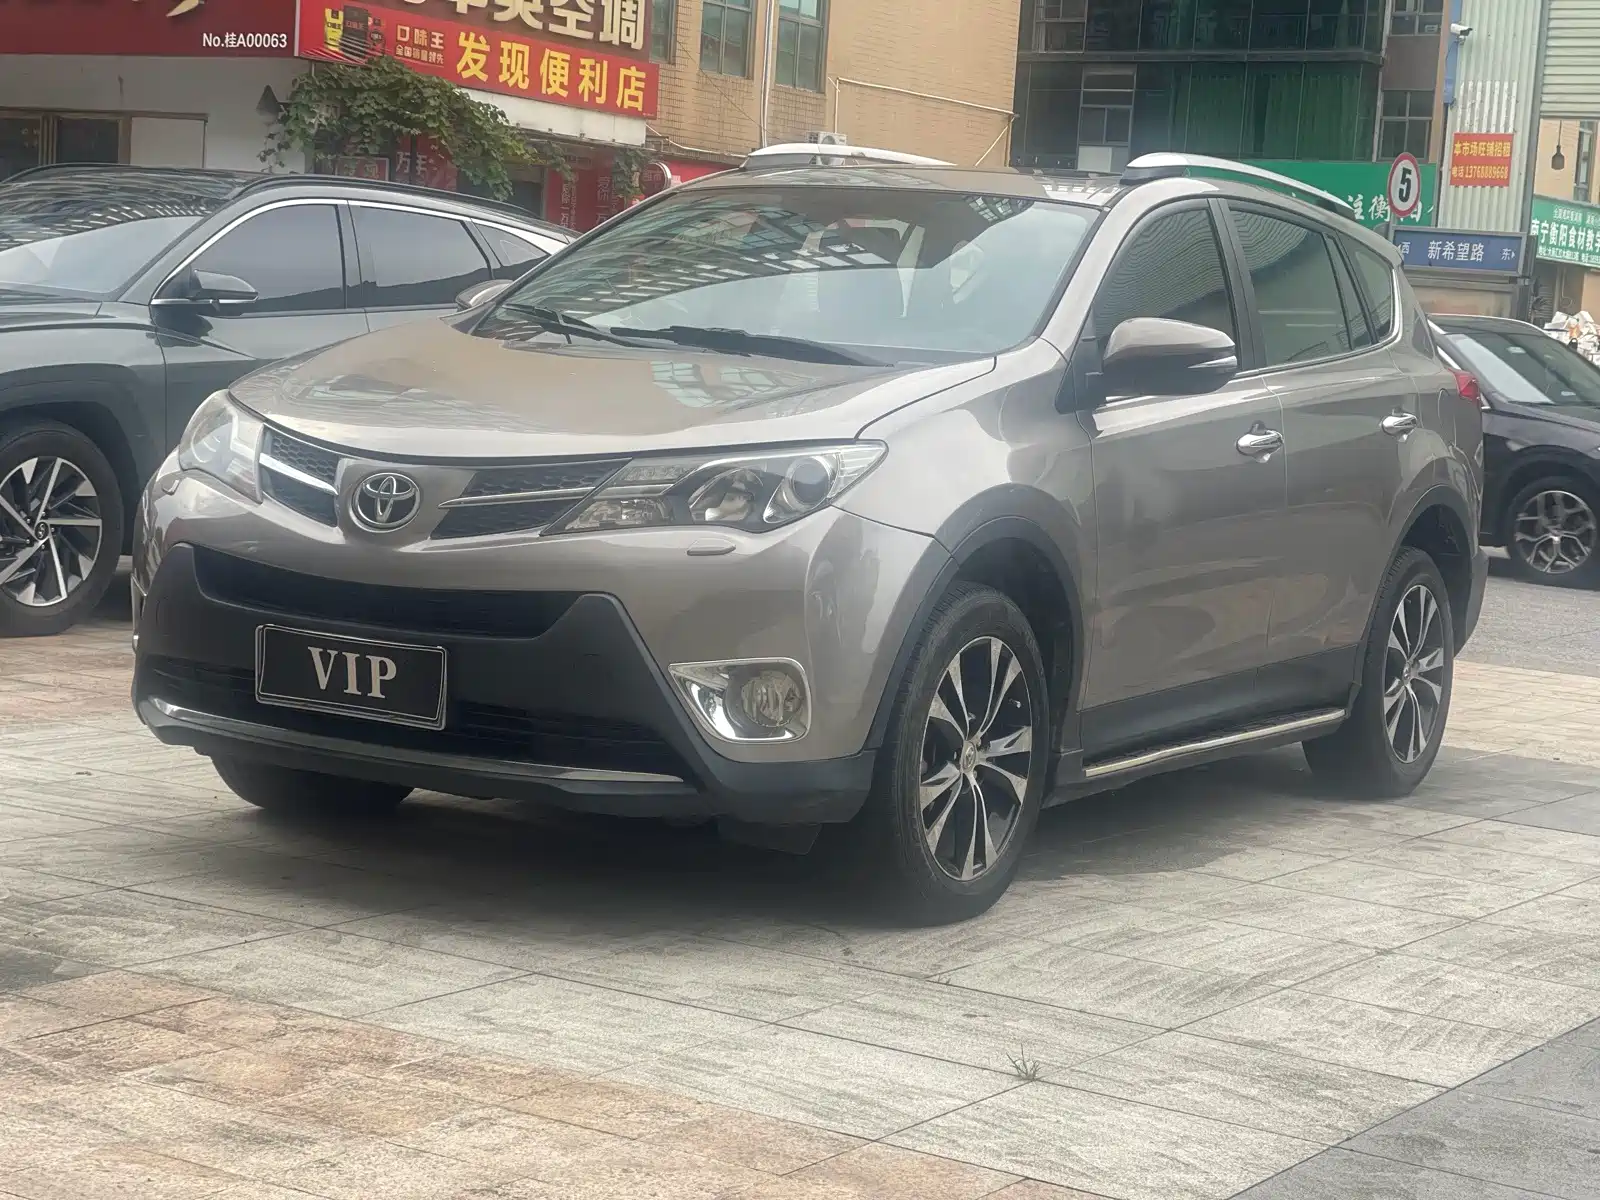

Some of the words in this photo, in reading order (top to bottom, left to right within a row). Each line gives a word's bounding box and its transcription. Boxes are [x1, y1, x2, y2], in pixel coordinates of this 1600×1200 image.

[202, 32, 288, 48] No.桂A00063
[396, 24, 444, 50] 口味王
[456, 31, 647, 111] 发现便利店
[1454, 140, 1511, 157] 本市场旺铺招租
[1452, 165, 1464, 178] 电话
[1398, 167, 1412, 203] 5
[1401, 241, 1411, 254] 西
[1427, 240, 1485, 262] 新希望路
[1501, 248, 1512, 261] 东
[308, 646, 397, 698] VIP
